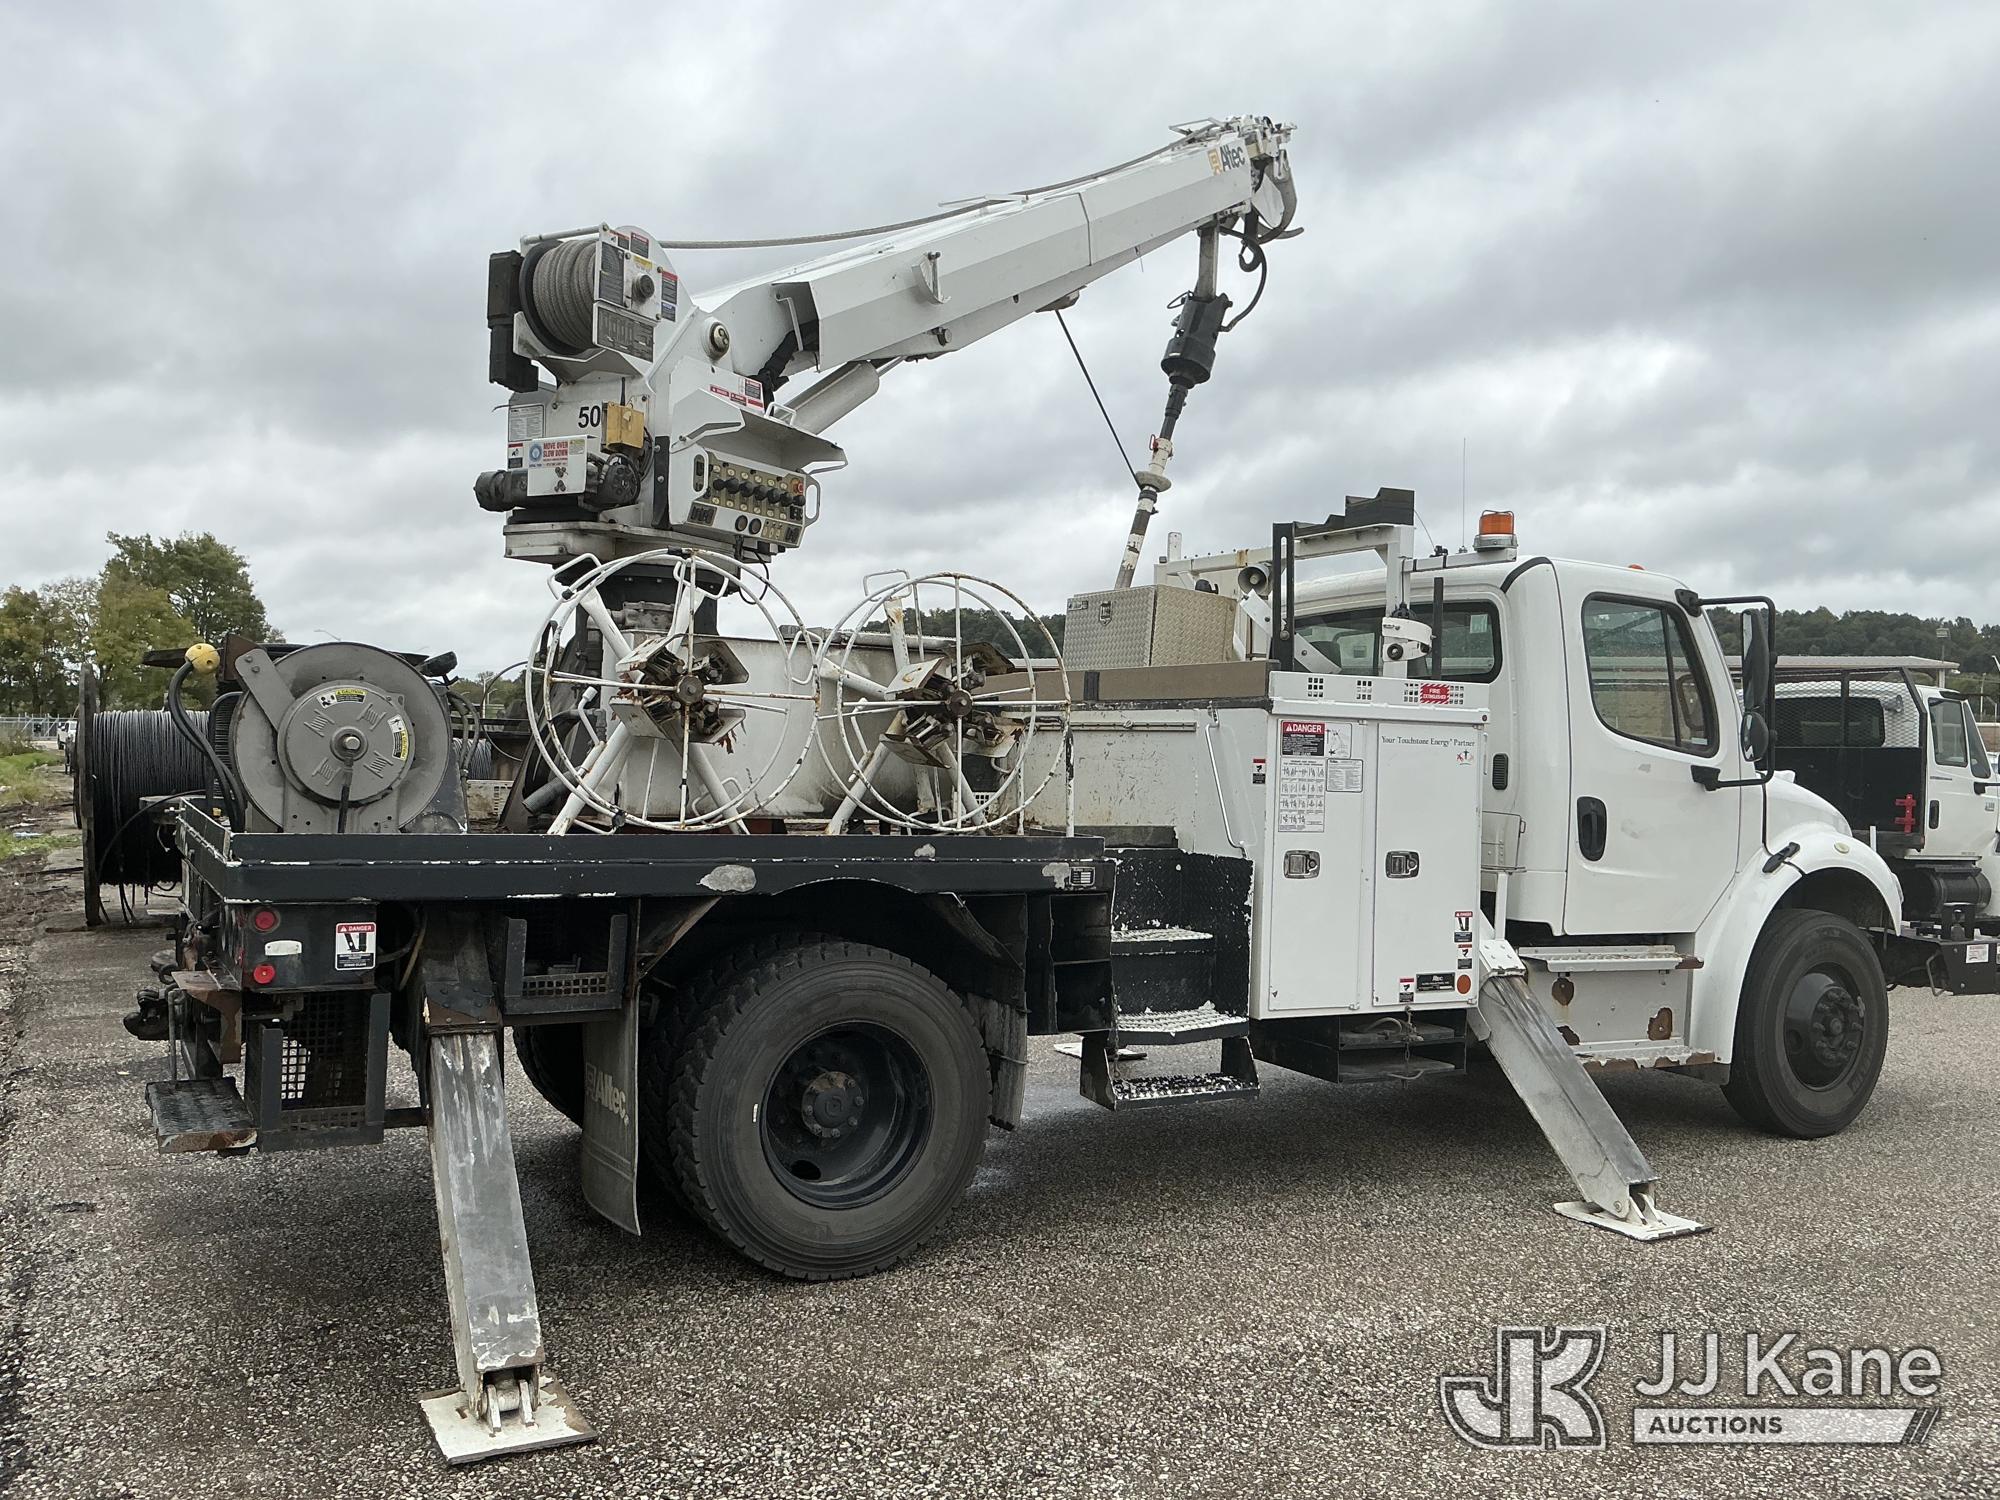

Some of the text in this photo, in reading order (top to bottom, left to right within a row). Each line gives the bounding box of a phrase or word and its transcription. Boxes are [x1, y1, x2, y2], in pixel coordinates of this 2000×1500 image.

[1220, 144, 1245, 171] Altec
[557, 441, 568, 449] OVER
[555, 449, 568, 457] DOWN
[1292, 723, 1322, 733] DANGER
[1381, 736, 1395, 744] Your
[1397, 736, 1429, 745] Touchstone
[1453, 738, 1475, 747] Partner
[596, 1071, 626, 1119] Altec
